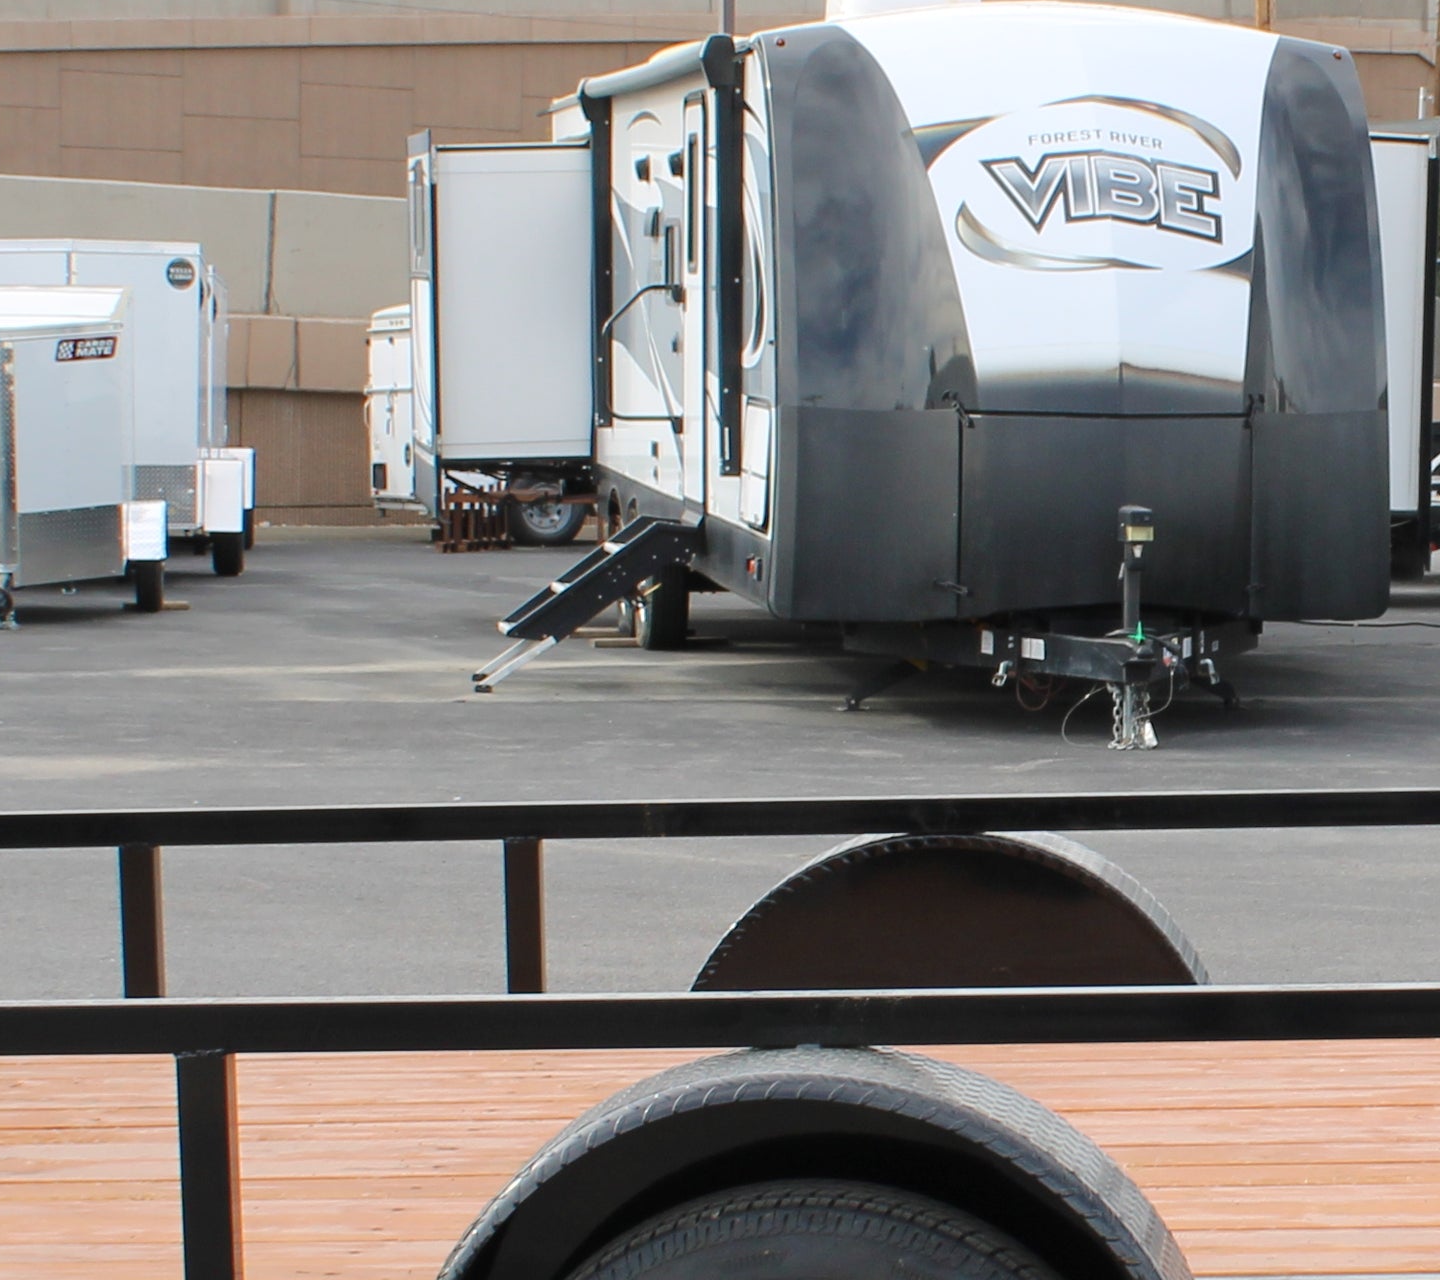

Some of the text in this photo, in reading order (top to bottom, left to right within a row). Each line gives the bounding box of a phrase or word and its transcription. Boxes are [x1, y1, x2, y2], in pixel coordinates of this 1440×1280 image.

[1027, 128, 1163, 150] FOREST RIVER
[979, 149, 1223, 245] VIBE
[77, 338, 114, 348] CARGO
[75, 347, 113, 357] MATE
